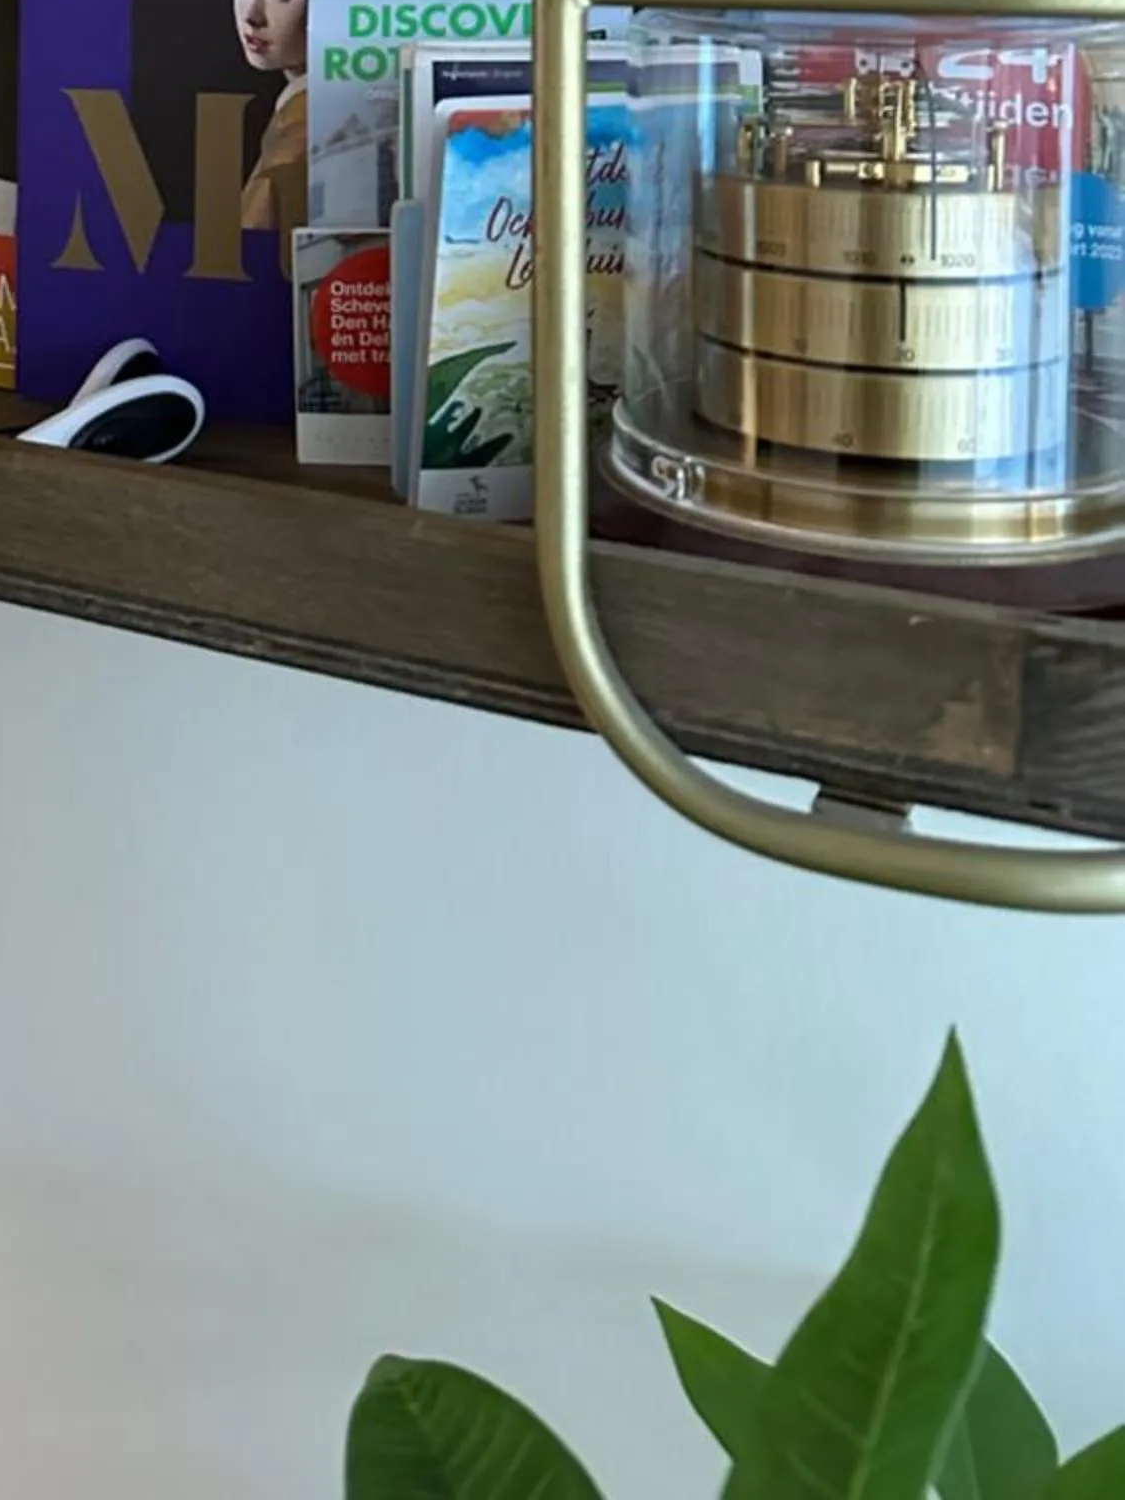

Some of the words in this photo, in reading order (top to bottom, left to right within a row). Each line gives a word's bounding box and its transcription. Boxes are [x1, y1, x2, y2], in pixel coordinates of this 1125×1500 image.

[348, 3, 532, 39] DISCOV
[330, 315, 368, 330] Den
[330, 349, 367, 364] met
[371, 349, 392, 364] tr
